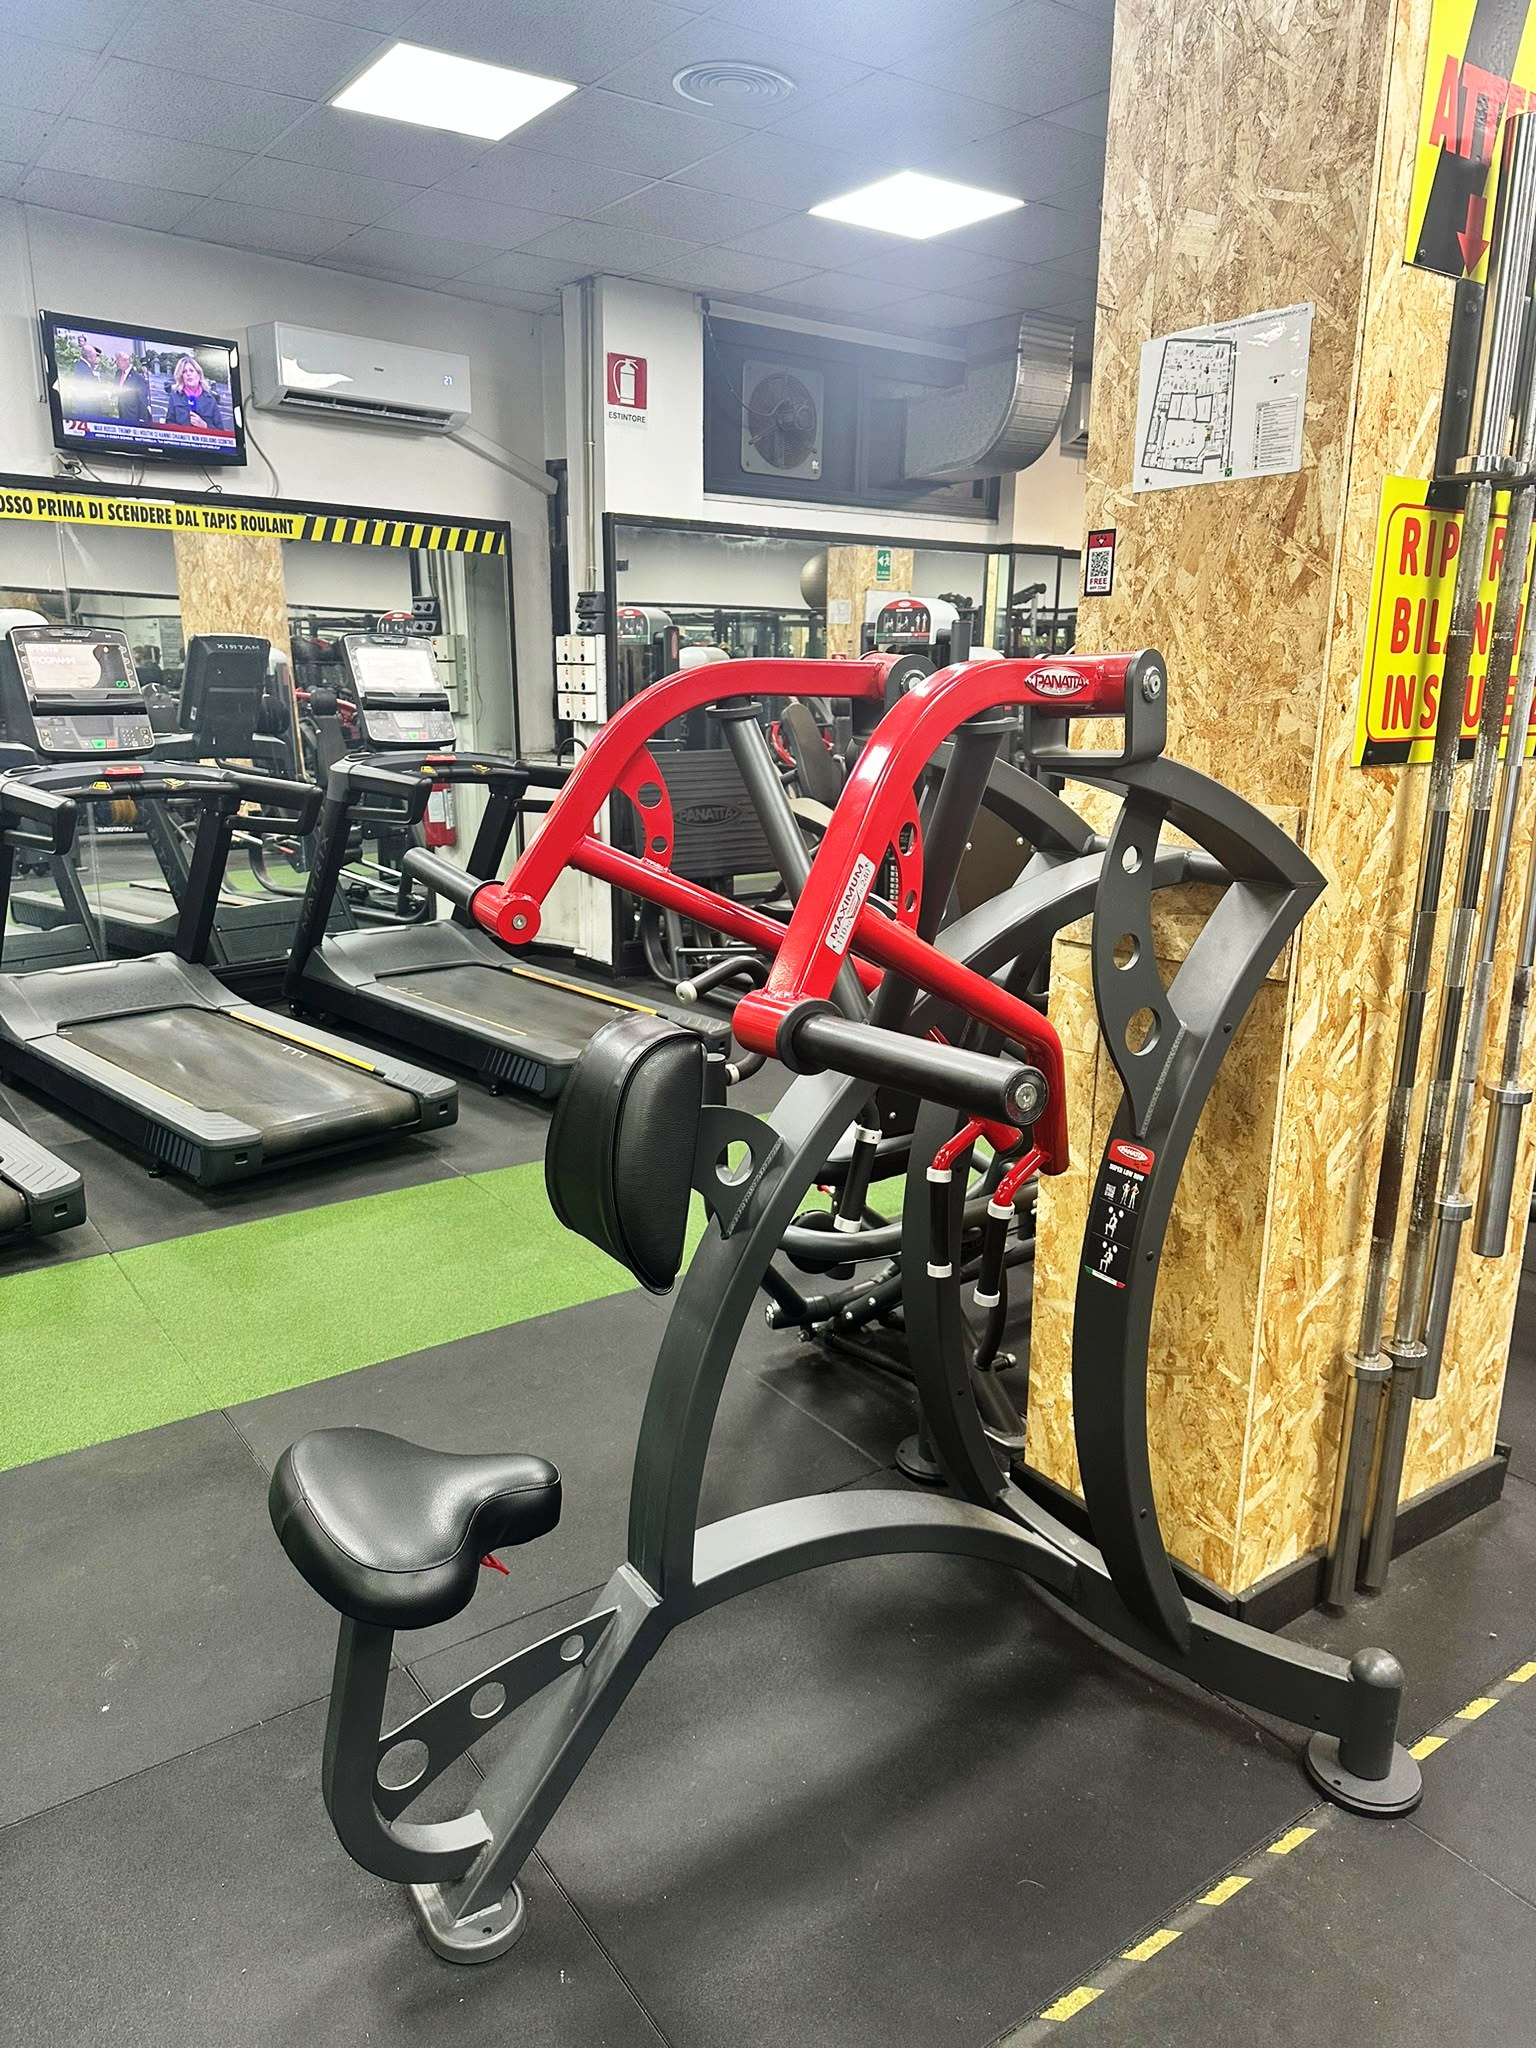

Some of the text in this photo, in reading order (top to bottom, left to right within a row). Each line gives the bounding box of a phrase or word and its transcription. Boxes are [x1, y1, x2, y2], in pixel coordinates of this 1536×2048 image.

[608, 411, 646, 423] ESTINTORE
[37, 497, 85, 518] PRIMA
[88, 501, 104, 519] DI
[107, 503, 171, 524] SCENDERE
[175, 509, 200, 527] DAL
[202, 511, 237, 530] TAPIS
[240, 514, 294, 534] ROULANT
[1089, 577, 1108, 585] FREE
[1034, 674, 1085, 689] PANATTA
[1381, 674, 1417, 730] IN
[680, 806, 735, 822] PANATTA
[830, 863, 864, 939] MAXIMUM
